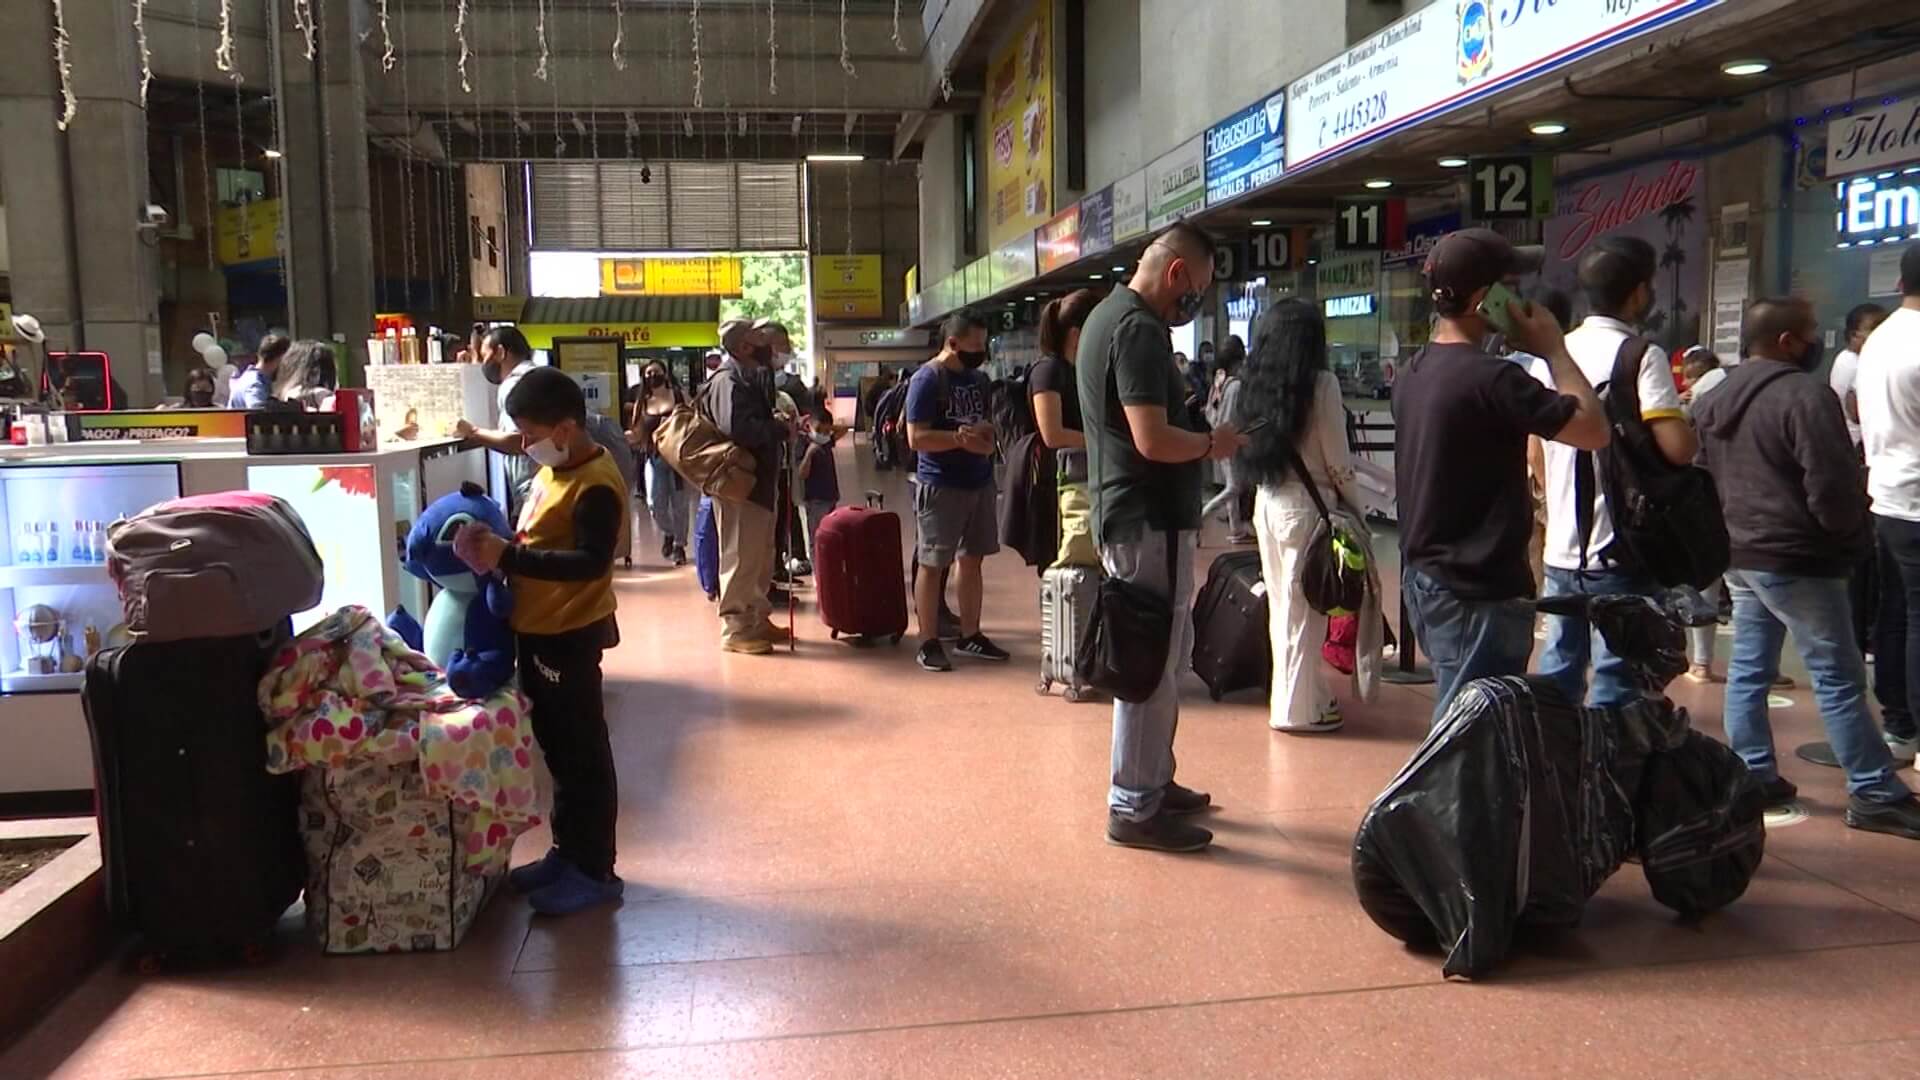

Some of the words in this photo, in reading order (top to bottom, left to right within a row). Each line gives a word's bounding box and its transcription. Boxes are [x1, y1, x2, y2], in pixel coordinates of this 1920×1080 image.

[1333, 90, 1388, 139] 4445328
[1476, 164, 1528, 212] 12
[1341, 205, 1379, 244] 11
[1560, 159, 1697, 262] Salento
[1252, 232, 1288, 267] 10
[1003, 311, 1014, 330] 3
